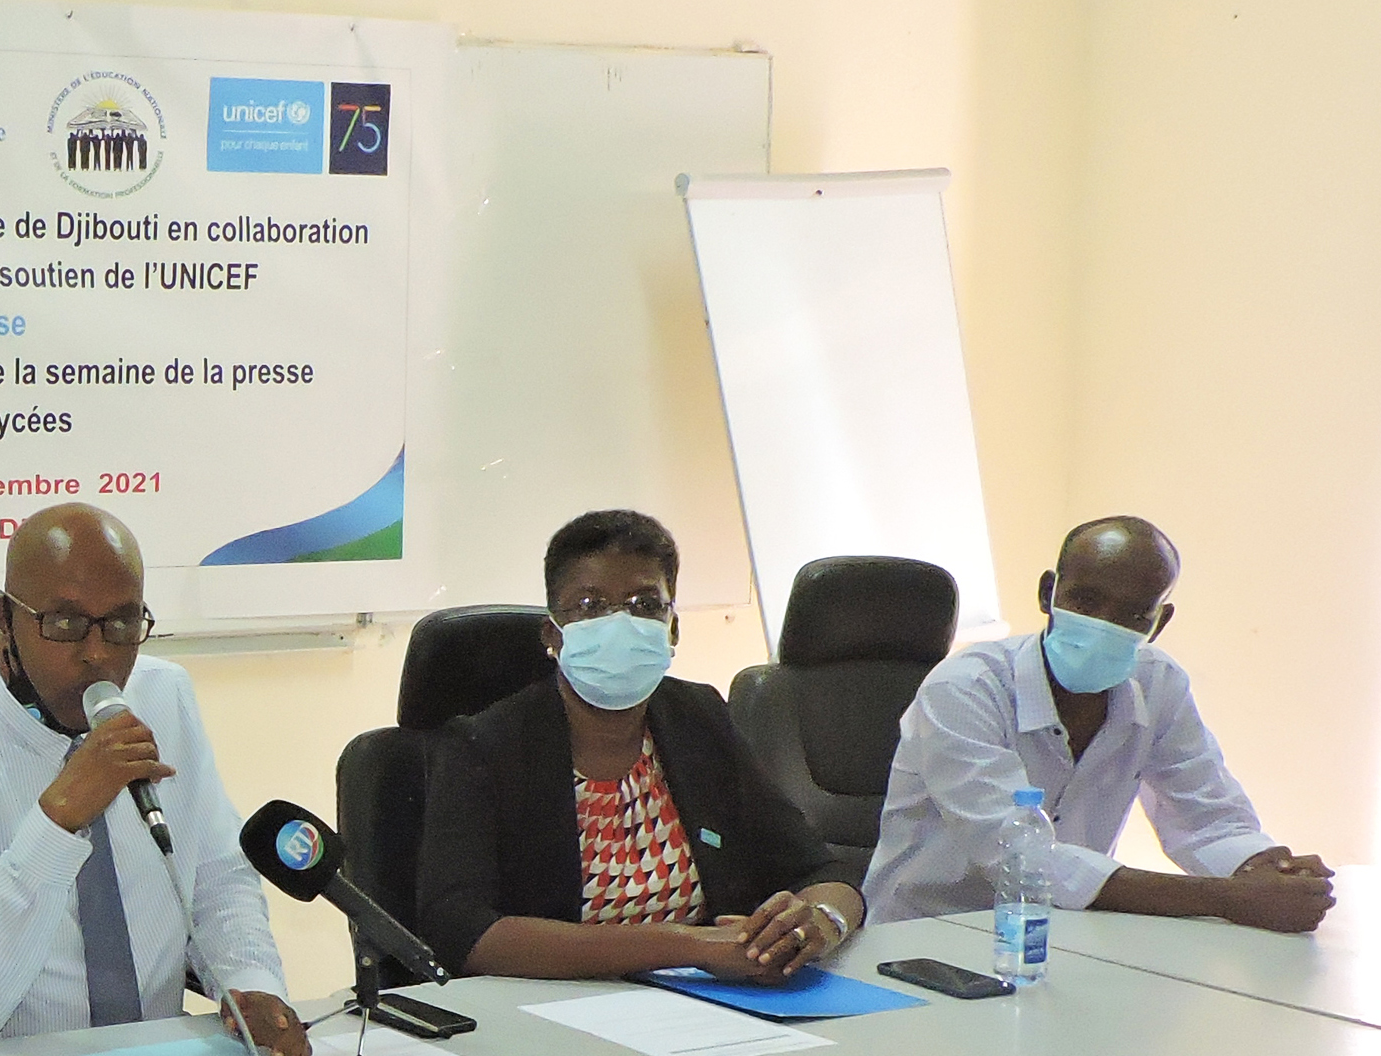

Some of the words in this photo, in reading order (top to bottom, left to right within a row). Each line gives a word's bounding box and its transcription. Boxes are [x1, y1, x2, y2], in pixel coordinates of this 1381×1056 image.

[223, 100, 286, 124] unicef
[338, 103, 382, 154] 75
[221, 139, 243, 151] pour
[245, 139, 279, 153] chaque
[280, 139, 309, 152] enfant
[15, 211, 46, 238] de
[57, 212, 158, 247] Djibouti
[168, 221, 197, 241] en
[208, 216, 368, 244] collaboration
[0, 261, 94, 288] soutien
[105, 262, 134, 289] de
[145, 262, 258, 289] l’UNICEF
[15, 358, 35, 384] la
[46, 358, 155, 384] semaine
[165, 358, 193, 384] de
[204, 358, 222, 384] la
[233, 365, 313, 390] presse
[99, 472, 161, 493] 2021
